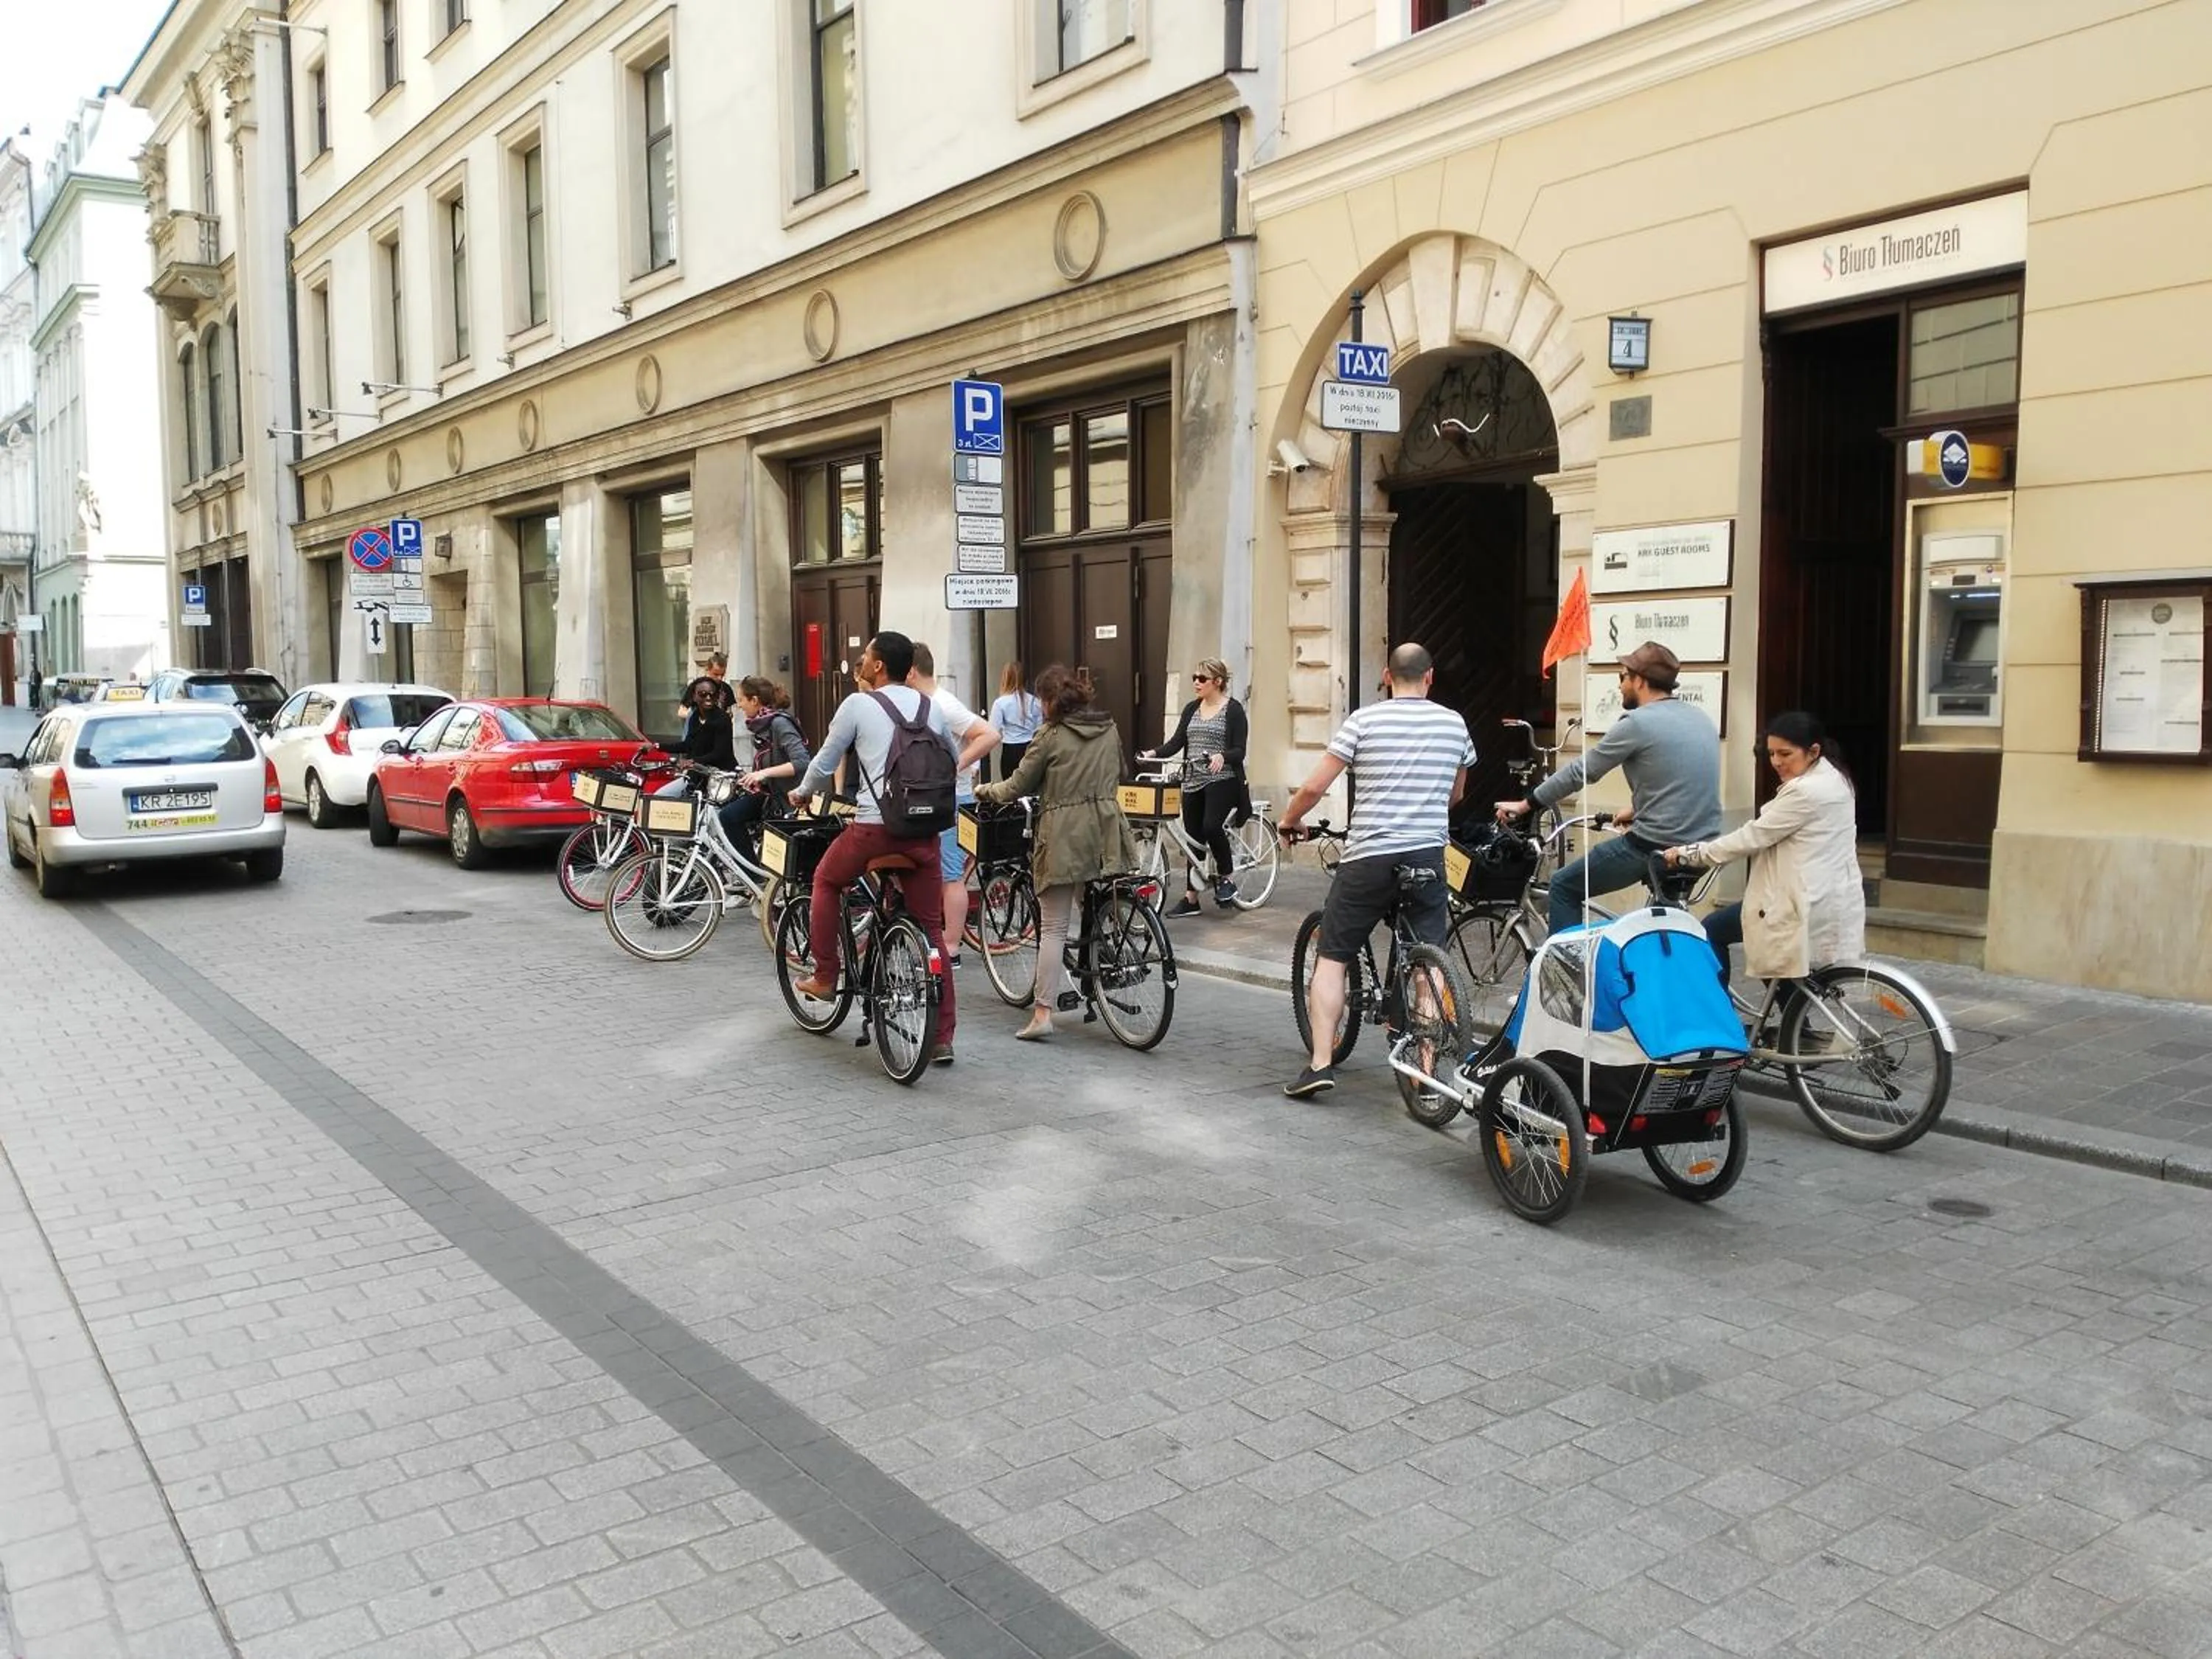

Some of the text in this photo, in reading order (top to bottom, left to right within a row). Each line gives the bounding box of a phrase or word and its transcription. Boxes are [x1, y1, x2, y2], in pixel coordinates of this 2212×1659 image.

[1839, 243, 1877, 276] Biuro
[1881, 224, 1961, 267] Tłumaczeń
[1623, 338, 1632, 358] 4
[1340, 347, 1388, 378] TAXI
[964, 387, 993, 431] P
[397, 523, 417, 546] P
[1654, 546, 1680, 557] GUEST
[1681, 543, 1711, 554] ROOMS
[188, 588, 201, 602] P
[140, 795, 161, 809] KR
